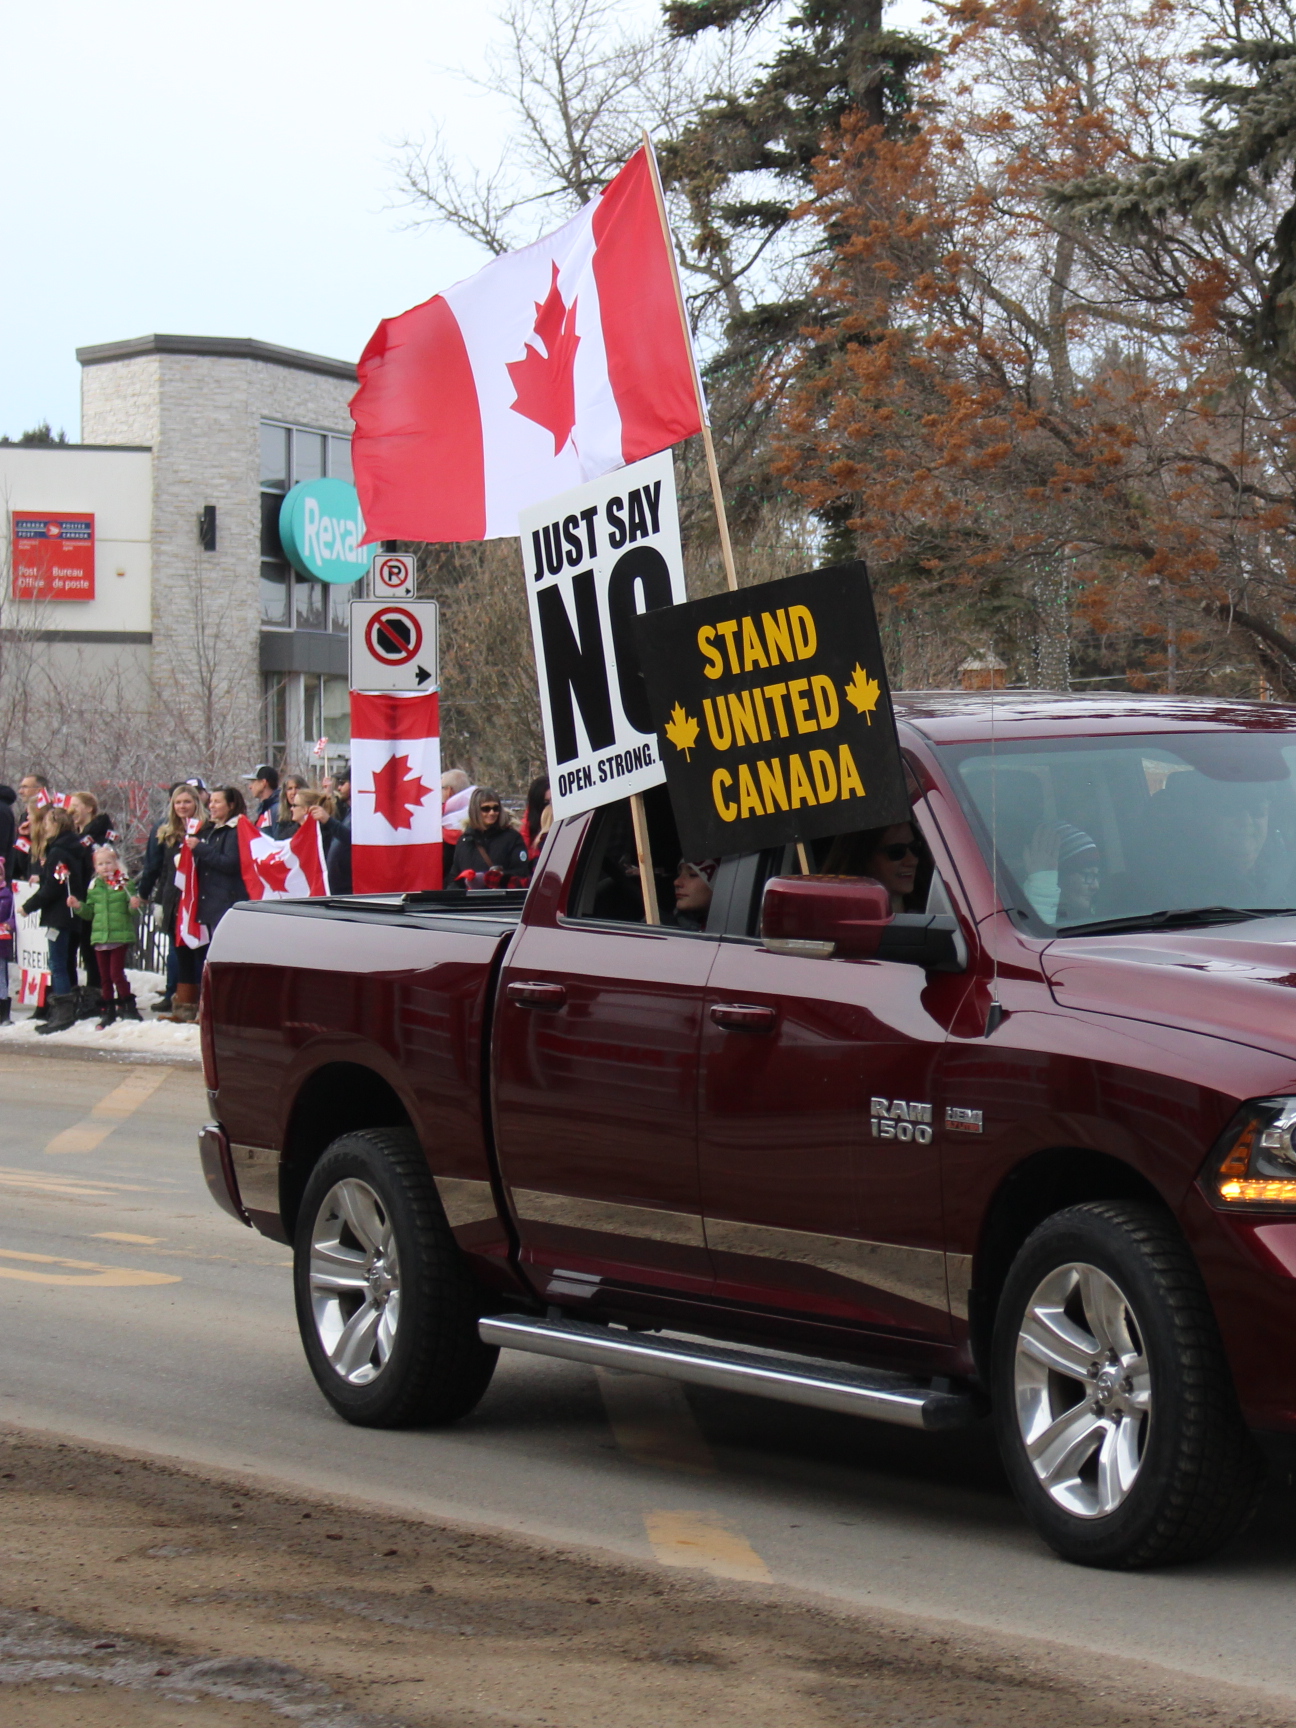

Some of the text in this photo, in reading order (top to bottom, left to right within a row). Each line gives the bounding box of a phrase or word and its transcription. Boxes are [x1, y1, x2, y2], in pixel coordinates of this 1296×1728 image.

[532, 480, 662, 582] JUST SAY
[18, 566, 38, 577] Post
[18, 577, 45, 588] Office
[52, 566, 84, 577] Bureau
[52, 578, 90, 591] de poste
[536, 545, 675, 766] NO
[697, 604, 818, 680] STAND
[702, 674, 840, 751] UNITED
[558, 765, 596, 798] OPEN.
[597, 743, 656, 783] STRONG.
[711, 743, 866, 823] CANADA
[870, 1097, 933, 1123] RAM
[870, 1118, 933, 1146] 1500
